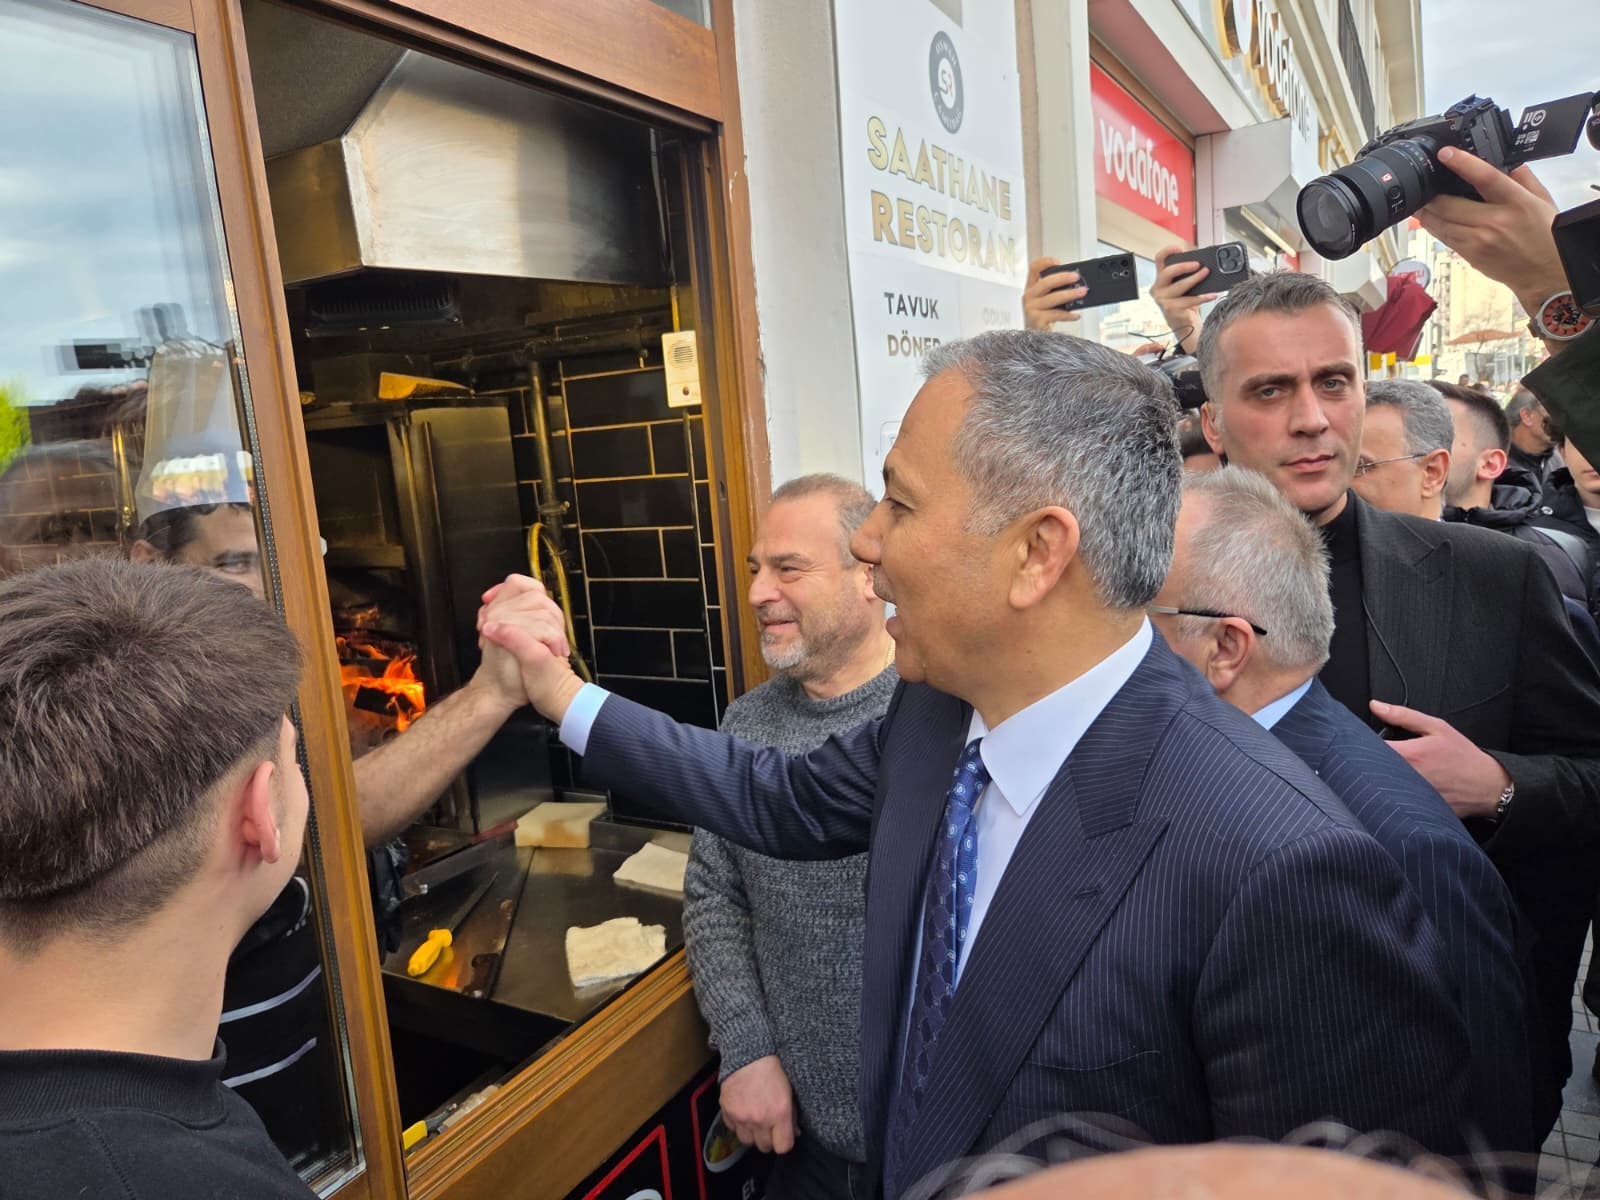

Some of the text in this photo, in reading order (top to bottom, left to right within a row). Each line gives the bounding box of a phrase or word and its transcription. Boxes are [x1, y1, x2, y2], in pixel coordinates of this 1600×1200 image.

[867, 115, 1012, 221] SAATHANE
[1099, 119, 1180, 217] vodafone
[871, 189, 1016, 277] RESTORAN
[884, 292, 939, 320] TAVUK
